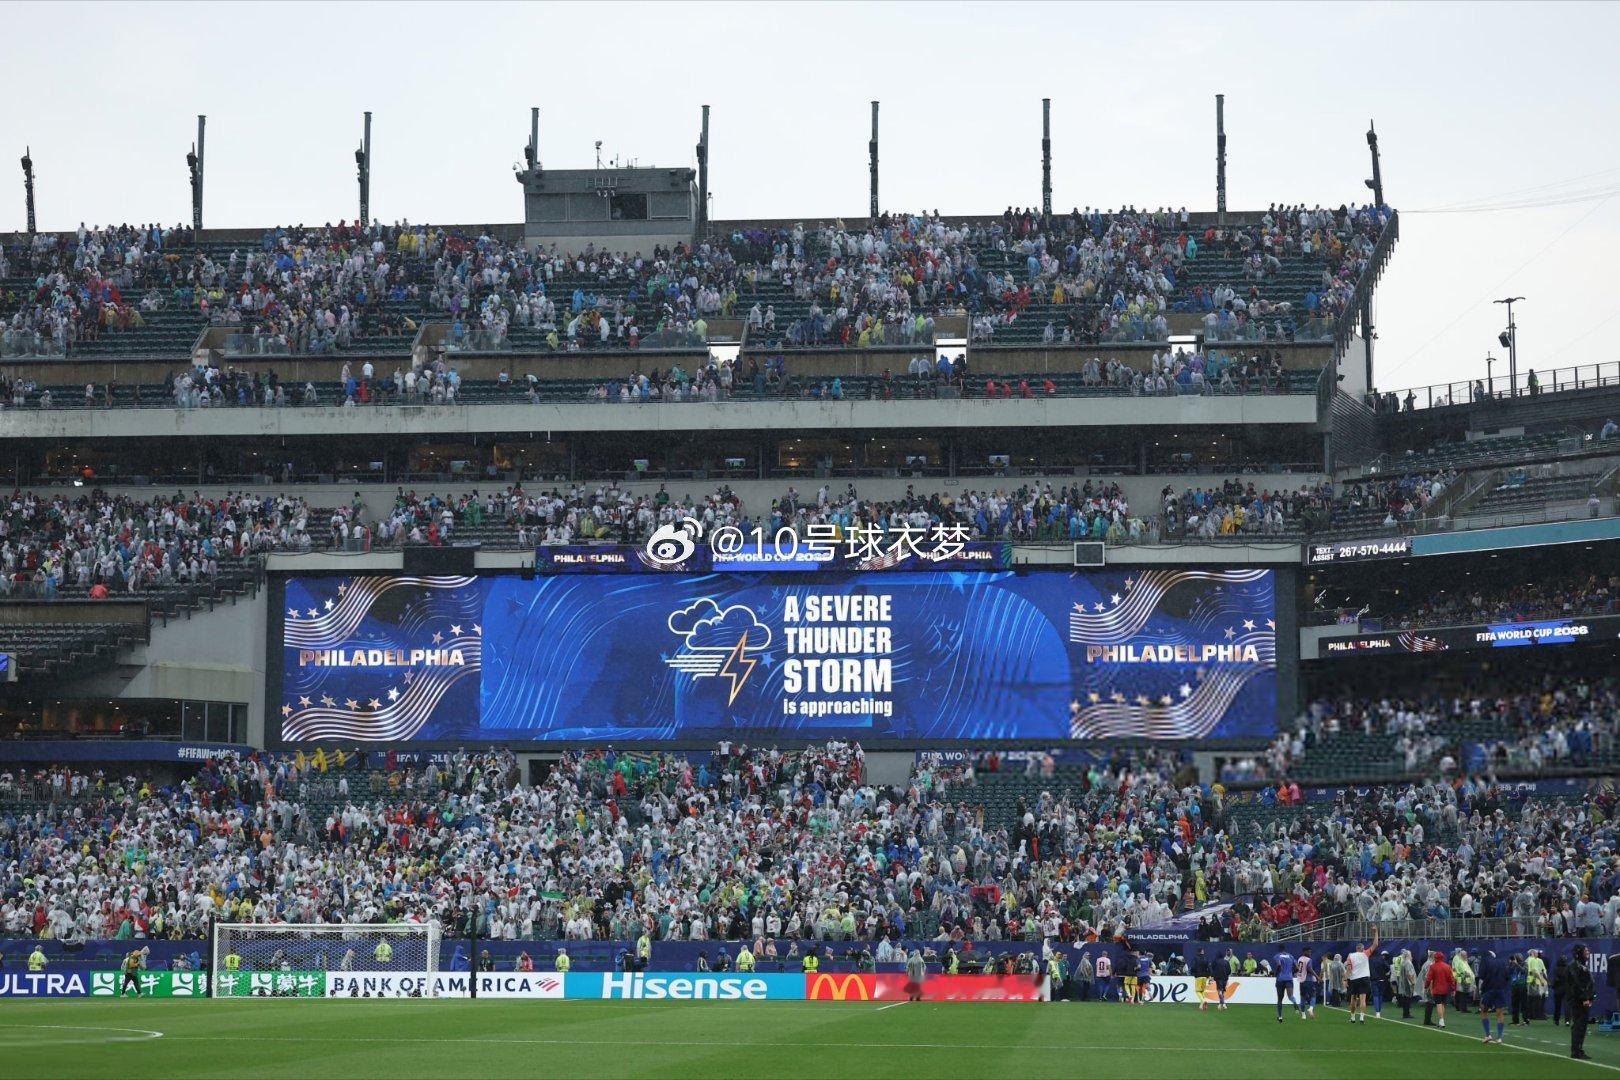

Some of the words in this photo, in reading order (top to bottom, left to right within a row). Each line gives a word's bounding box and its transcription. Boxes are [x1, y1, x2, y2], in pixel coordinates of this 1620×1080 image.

[920, 551, 992, 560] PHILELPHIA
[1312, 554, 1334, 562] ASSIST
[1315, 547, 1331, 555] TEXT
[1340, 541, 1407, 558] 267-570-4444
[553, 554, 625, 563] PHILADELPHIA
[783, 595, 800, 622] A
[805, 594, 892, 622] SEVERE
[784, 626, 892, 654] THUNDER
[1476, 631, 1497, 642] FIFA
[1498, 629, 1531, 641] WORLD
[1533, 628, 1552, 638] CUP
[1553, 625, 1589, 637] 2026
[1086, 644, 1260, 663] PHILADELPHIA
[1328, 640, 1391, 651] PHILADELPHIA
[299, 649, 465, 667] PHILADELPHIA
[783, 658, 892, 694] STORM
[799, 697, 893, 718] approaching
[920, 751, 944, 761] FIA
[1589, 953, 1608, 973] IFA
[333, 977, 393, 992] BANK
[399, 977, 427, 992] OF
[601, 972, 768, 999] Hisense
[1144, 982, 1189, 1003] ove
